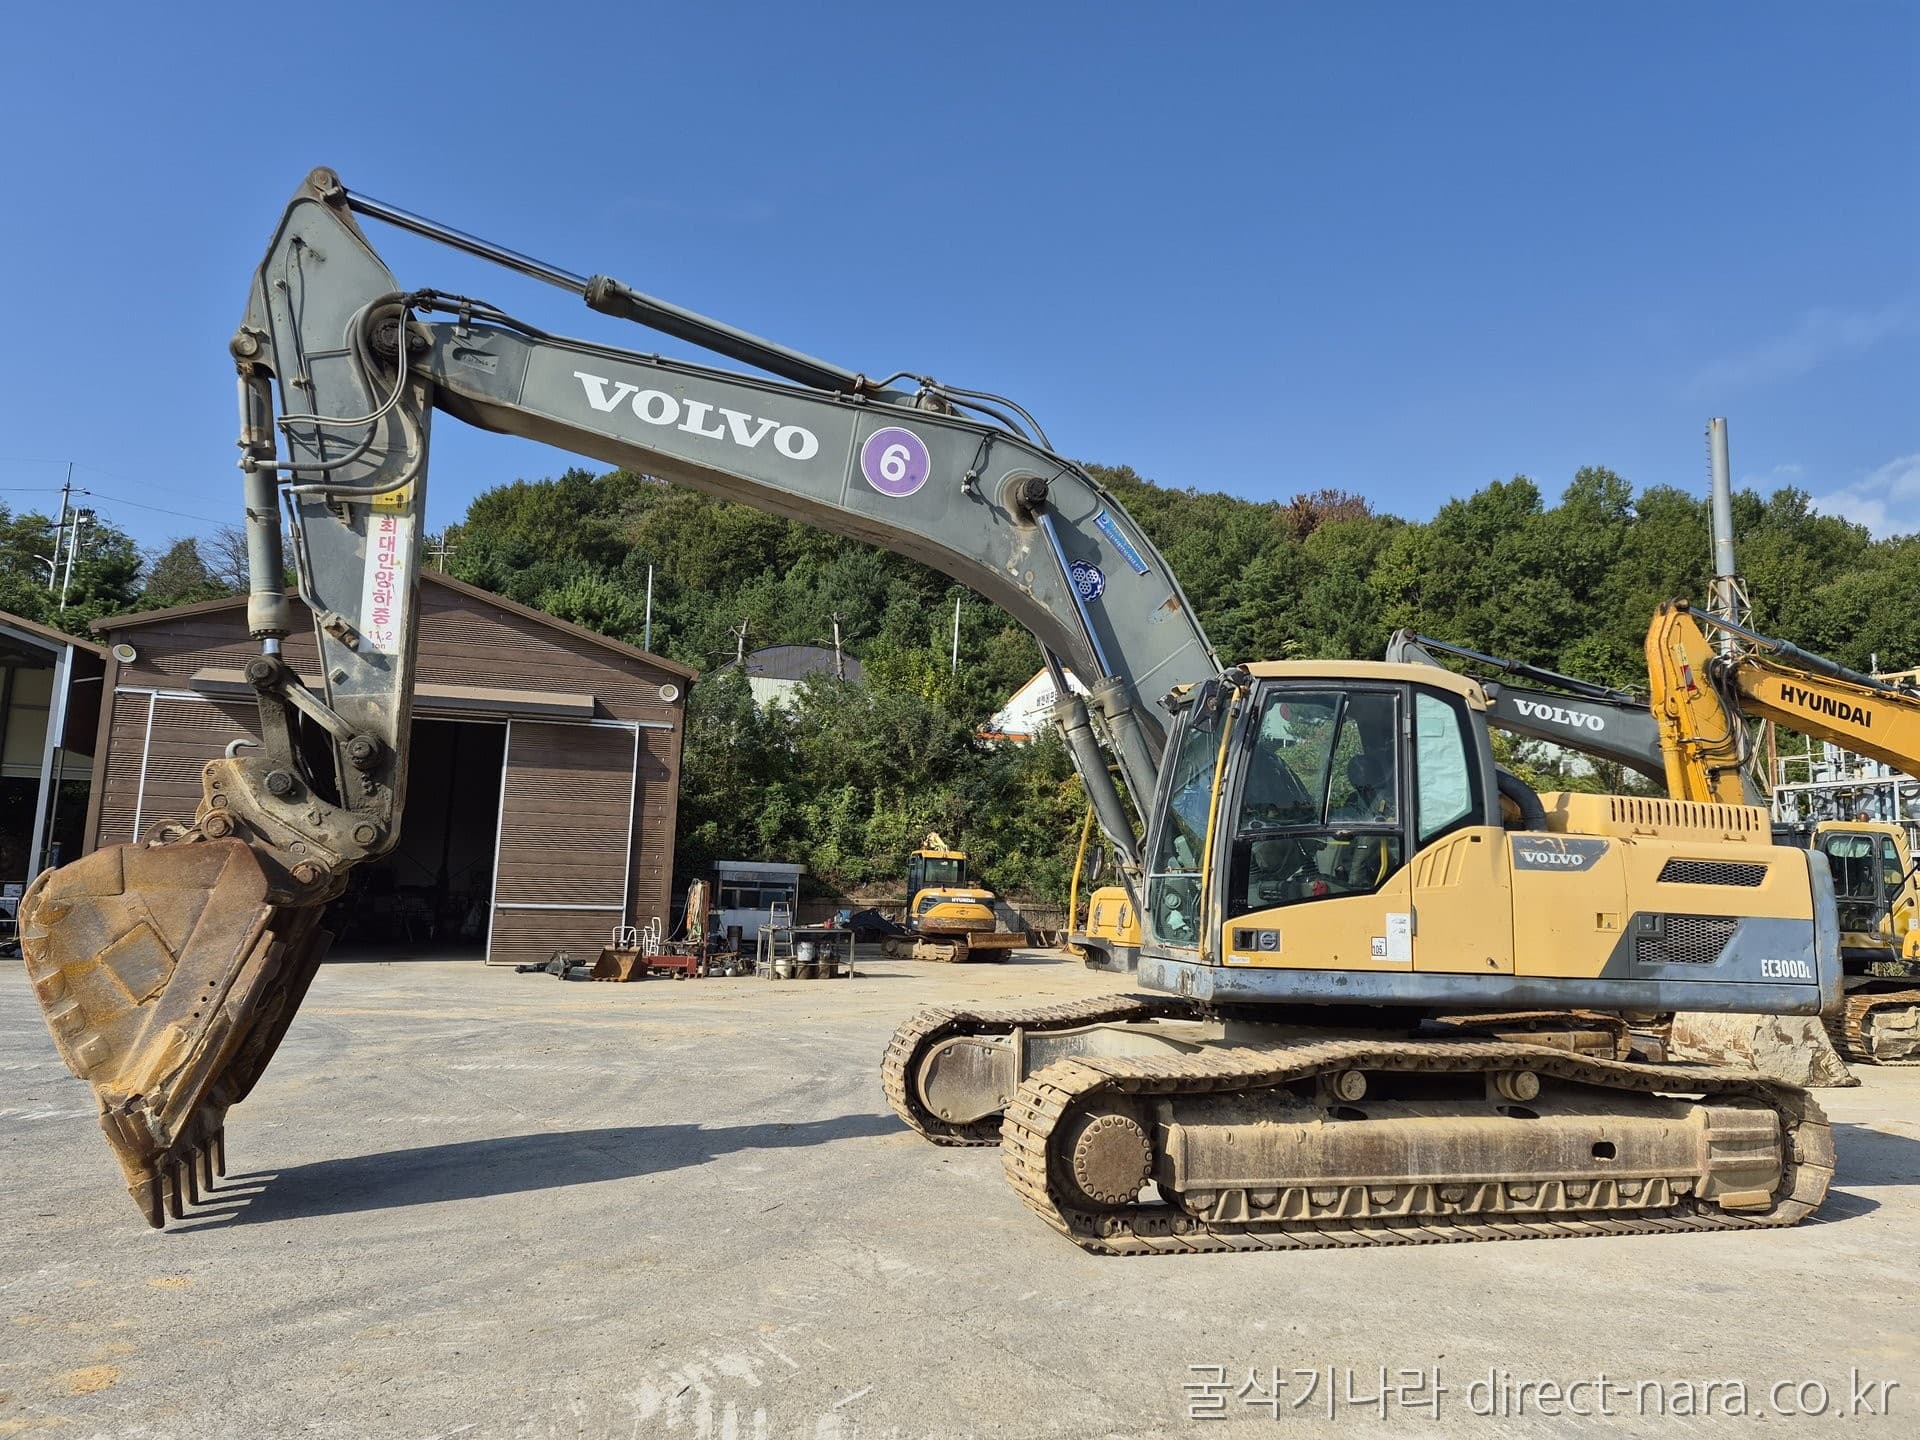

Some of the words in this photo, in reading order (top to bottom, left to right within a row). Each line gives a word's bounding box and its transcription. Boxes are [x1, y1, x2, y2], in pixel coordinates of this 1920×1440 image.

[573, 371, 819, 460] VOLVO
[879, 443, 911, 482] 6
[371, 514, 398, 625] 최대인양하중
[368, 630, 393, 641] 11.2
[1513, 698, 1605, 732] VOLVO
[1780, 683, 1872, 728] HYUNDAI
[1520, 851, 1584, 866] VOLVO
[1761, 959, 1812, 979] EC300DL
